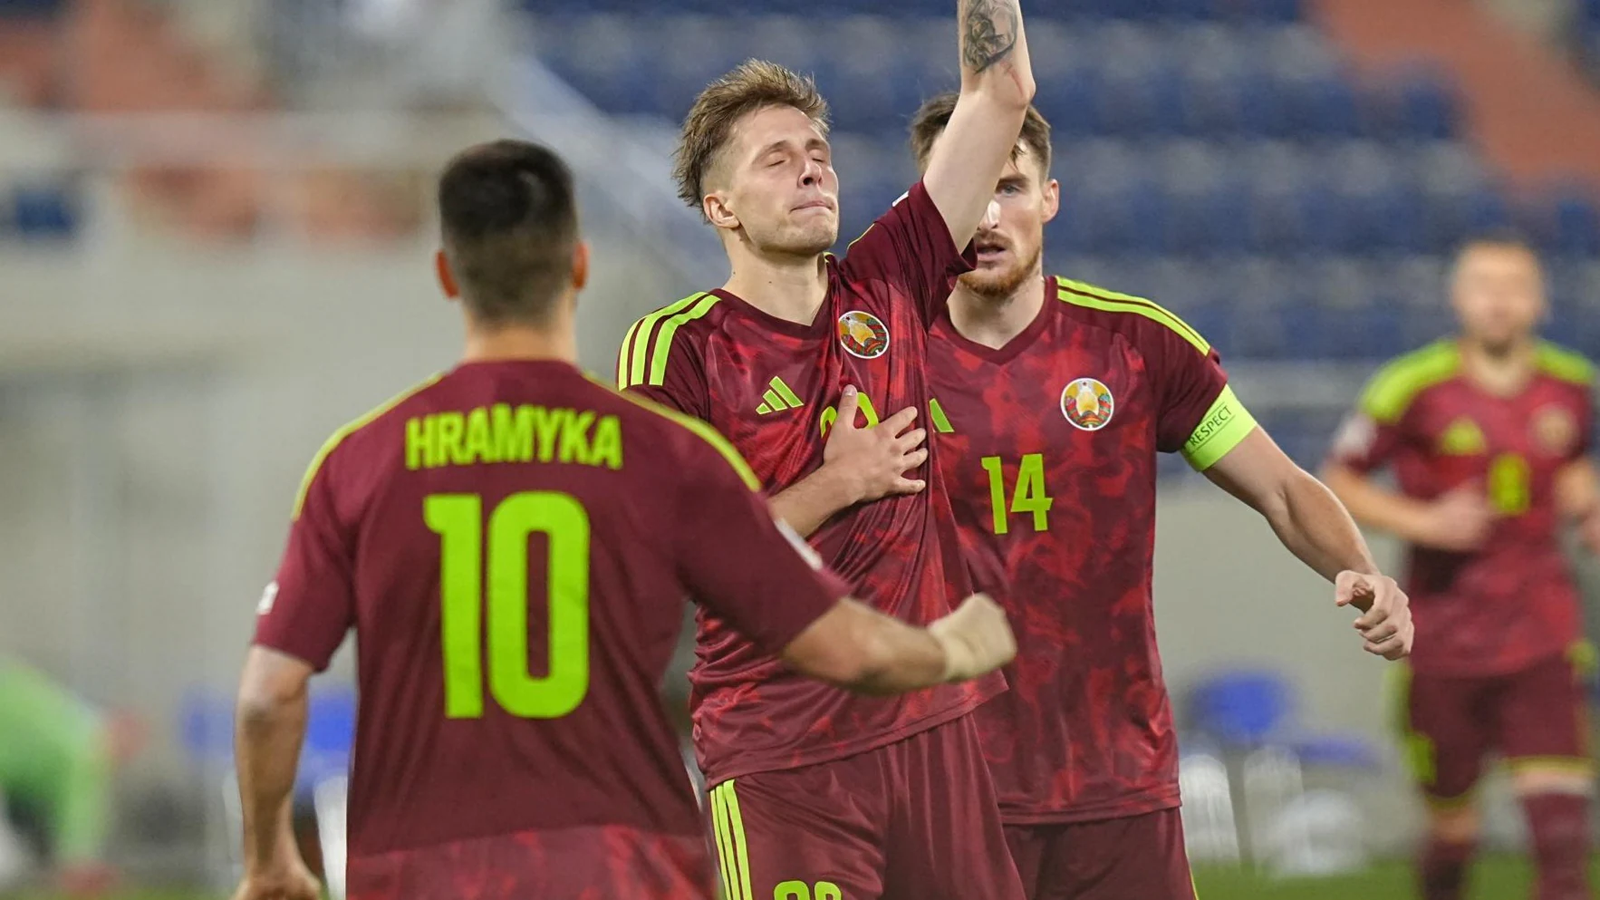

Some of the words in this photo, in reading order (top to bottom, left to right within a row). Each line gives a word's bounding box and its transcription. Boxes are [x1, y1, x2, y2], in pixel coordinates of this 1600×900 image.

[405, 402, 623, 470] HRAMYKA
[1189, 405, 1232, 447] RESPECT
[981, 453, 1054, 535] 14
[423, 490, 590, 719] 10
